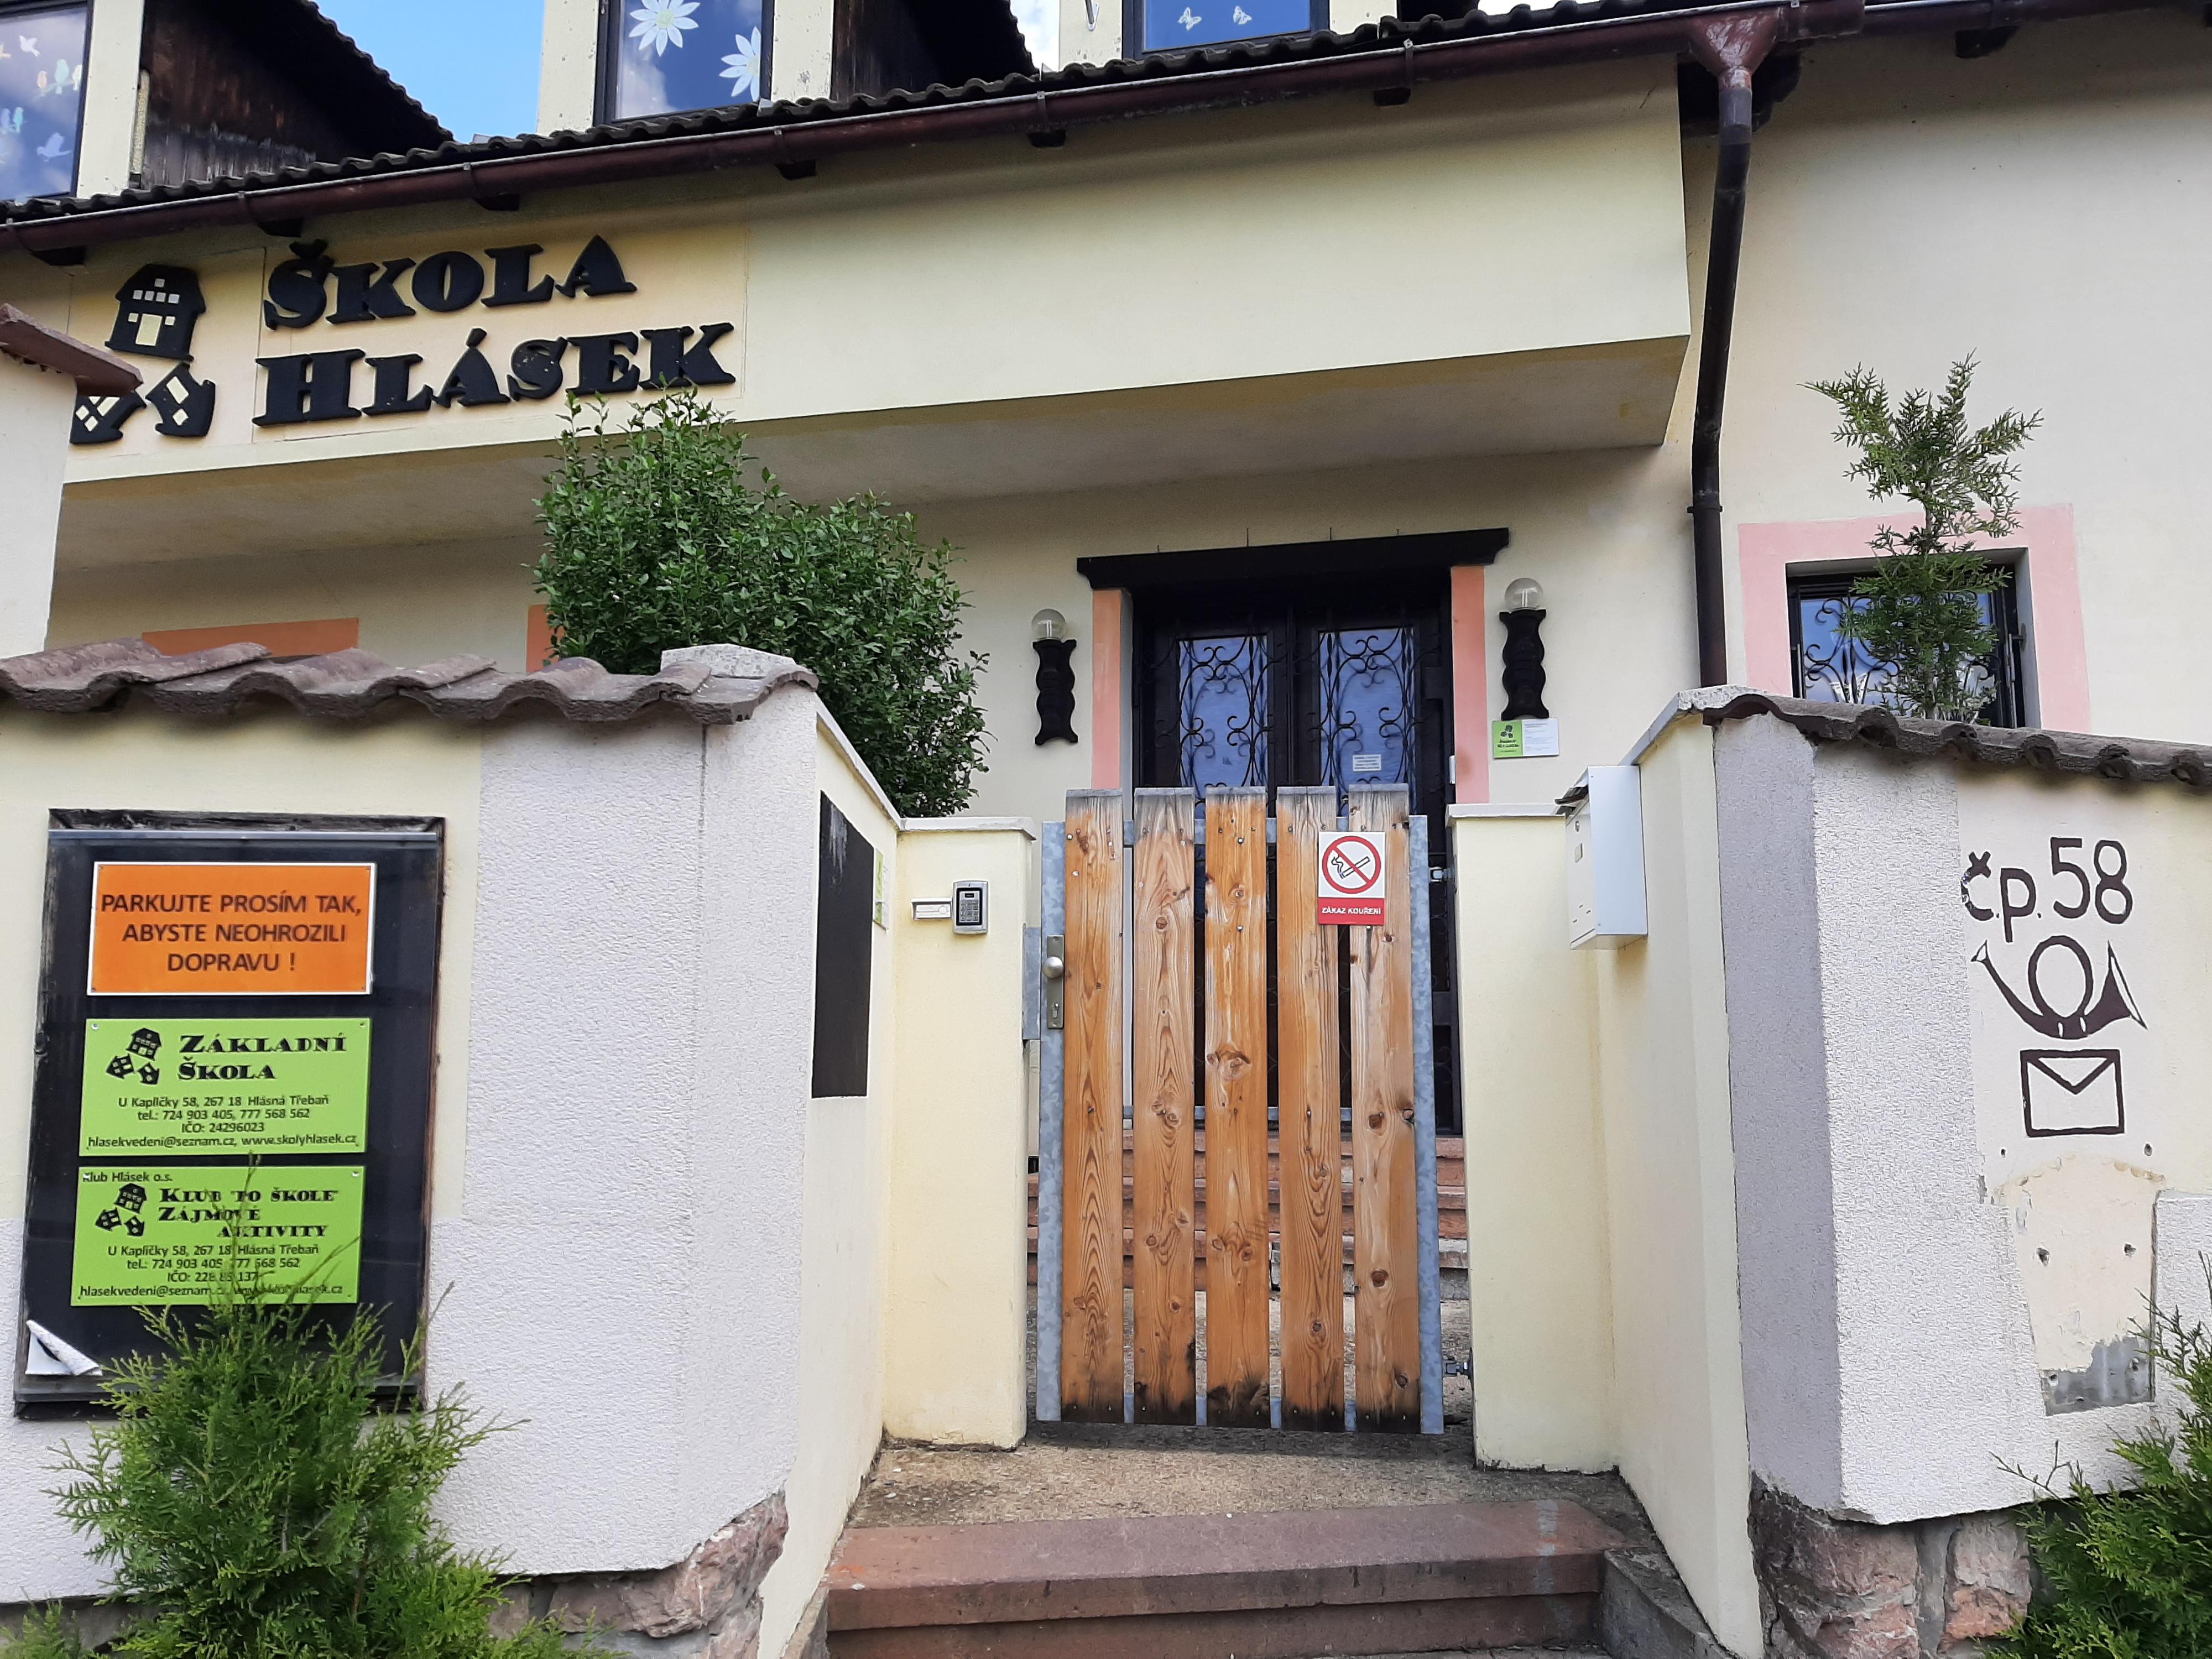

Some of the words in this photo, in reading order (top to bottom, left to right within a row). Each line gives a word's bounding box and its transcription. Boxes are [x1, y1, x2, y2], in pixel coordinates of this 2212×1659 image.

[264, 234, 637, 330] ŠKOLA
[252, 322, 735, 426] HLÁSEK
[101, 894, 212, 912] PARKUJTE
[220, 890, 306, 913] PROSÍM
[315, 895, 361, 916] TAK,
[1322, 906, 1346, 914] ZÁKAZ
[1348, 906, 1381, 915] KOUŘENÍ
[122, 924, 206, 942] ABYSTE
[215, 924, 346, 942] NEOHROZILI
[168, 953, 279, 972] DOPRAVU
[180, 1032, 347, 1053] ZÁKLADNÍ
[178, 1056, 276, 1080] ŠKOLA
[118, 1097, 127, 1107] U
[182, 1097, 200, 1108] 58,
[204, 1096, 223, 1107] 267
[228, 1097, 242, 1106] 18
[248, 1094, 285, 1105] Hlásná
[289, 1094, 330, 1105] Třebaň
[138, 1110, 159, 1120] tel.:
[163, 1110, 182, 1120] 724
[186, 1110, 208, 1120] 903
[211, 1110, 236, 1121] 405,
[239, 1109, 260, 1119] 777
[265, 1109, 285, 1118] 568
[289, 1108, 310, 1118] 562
[181, 1121, 205, 1133] IČO:
[209, 1122, 264, 1133] 24296023
[241, 1134, 356, 1146] www.skolyhlasek.cz
[112, 1172, 149, 1182] Hlásek
[108, 1246, 116, 1256] U
[194, 1245, 213, 1255] 267
[219, 1245, 231, 1255] 18
[238, 1244, 275, 1255] Hlásná
[279, 1244, 319, 1254] Třebaň
[127, 1259, 147, 1269] tel.:
[152, 1259, 172, 1269] 724
[176, 1259, 197, 1269] 903
[279, 1258, 299, 1267] 562
[168, 1270, 191, 1282] IČO:
[238, 1271, 258, 1281] 137
